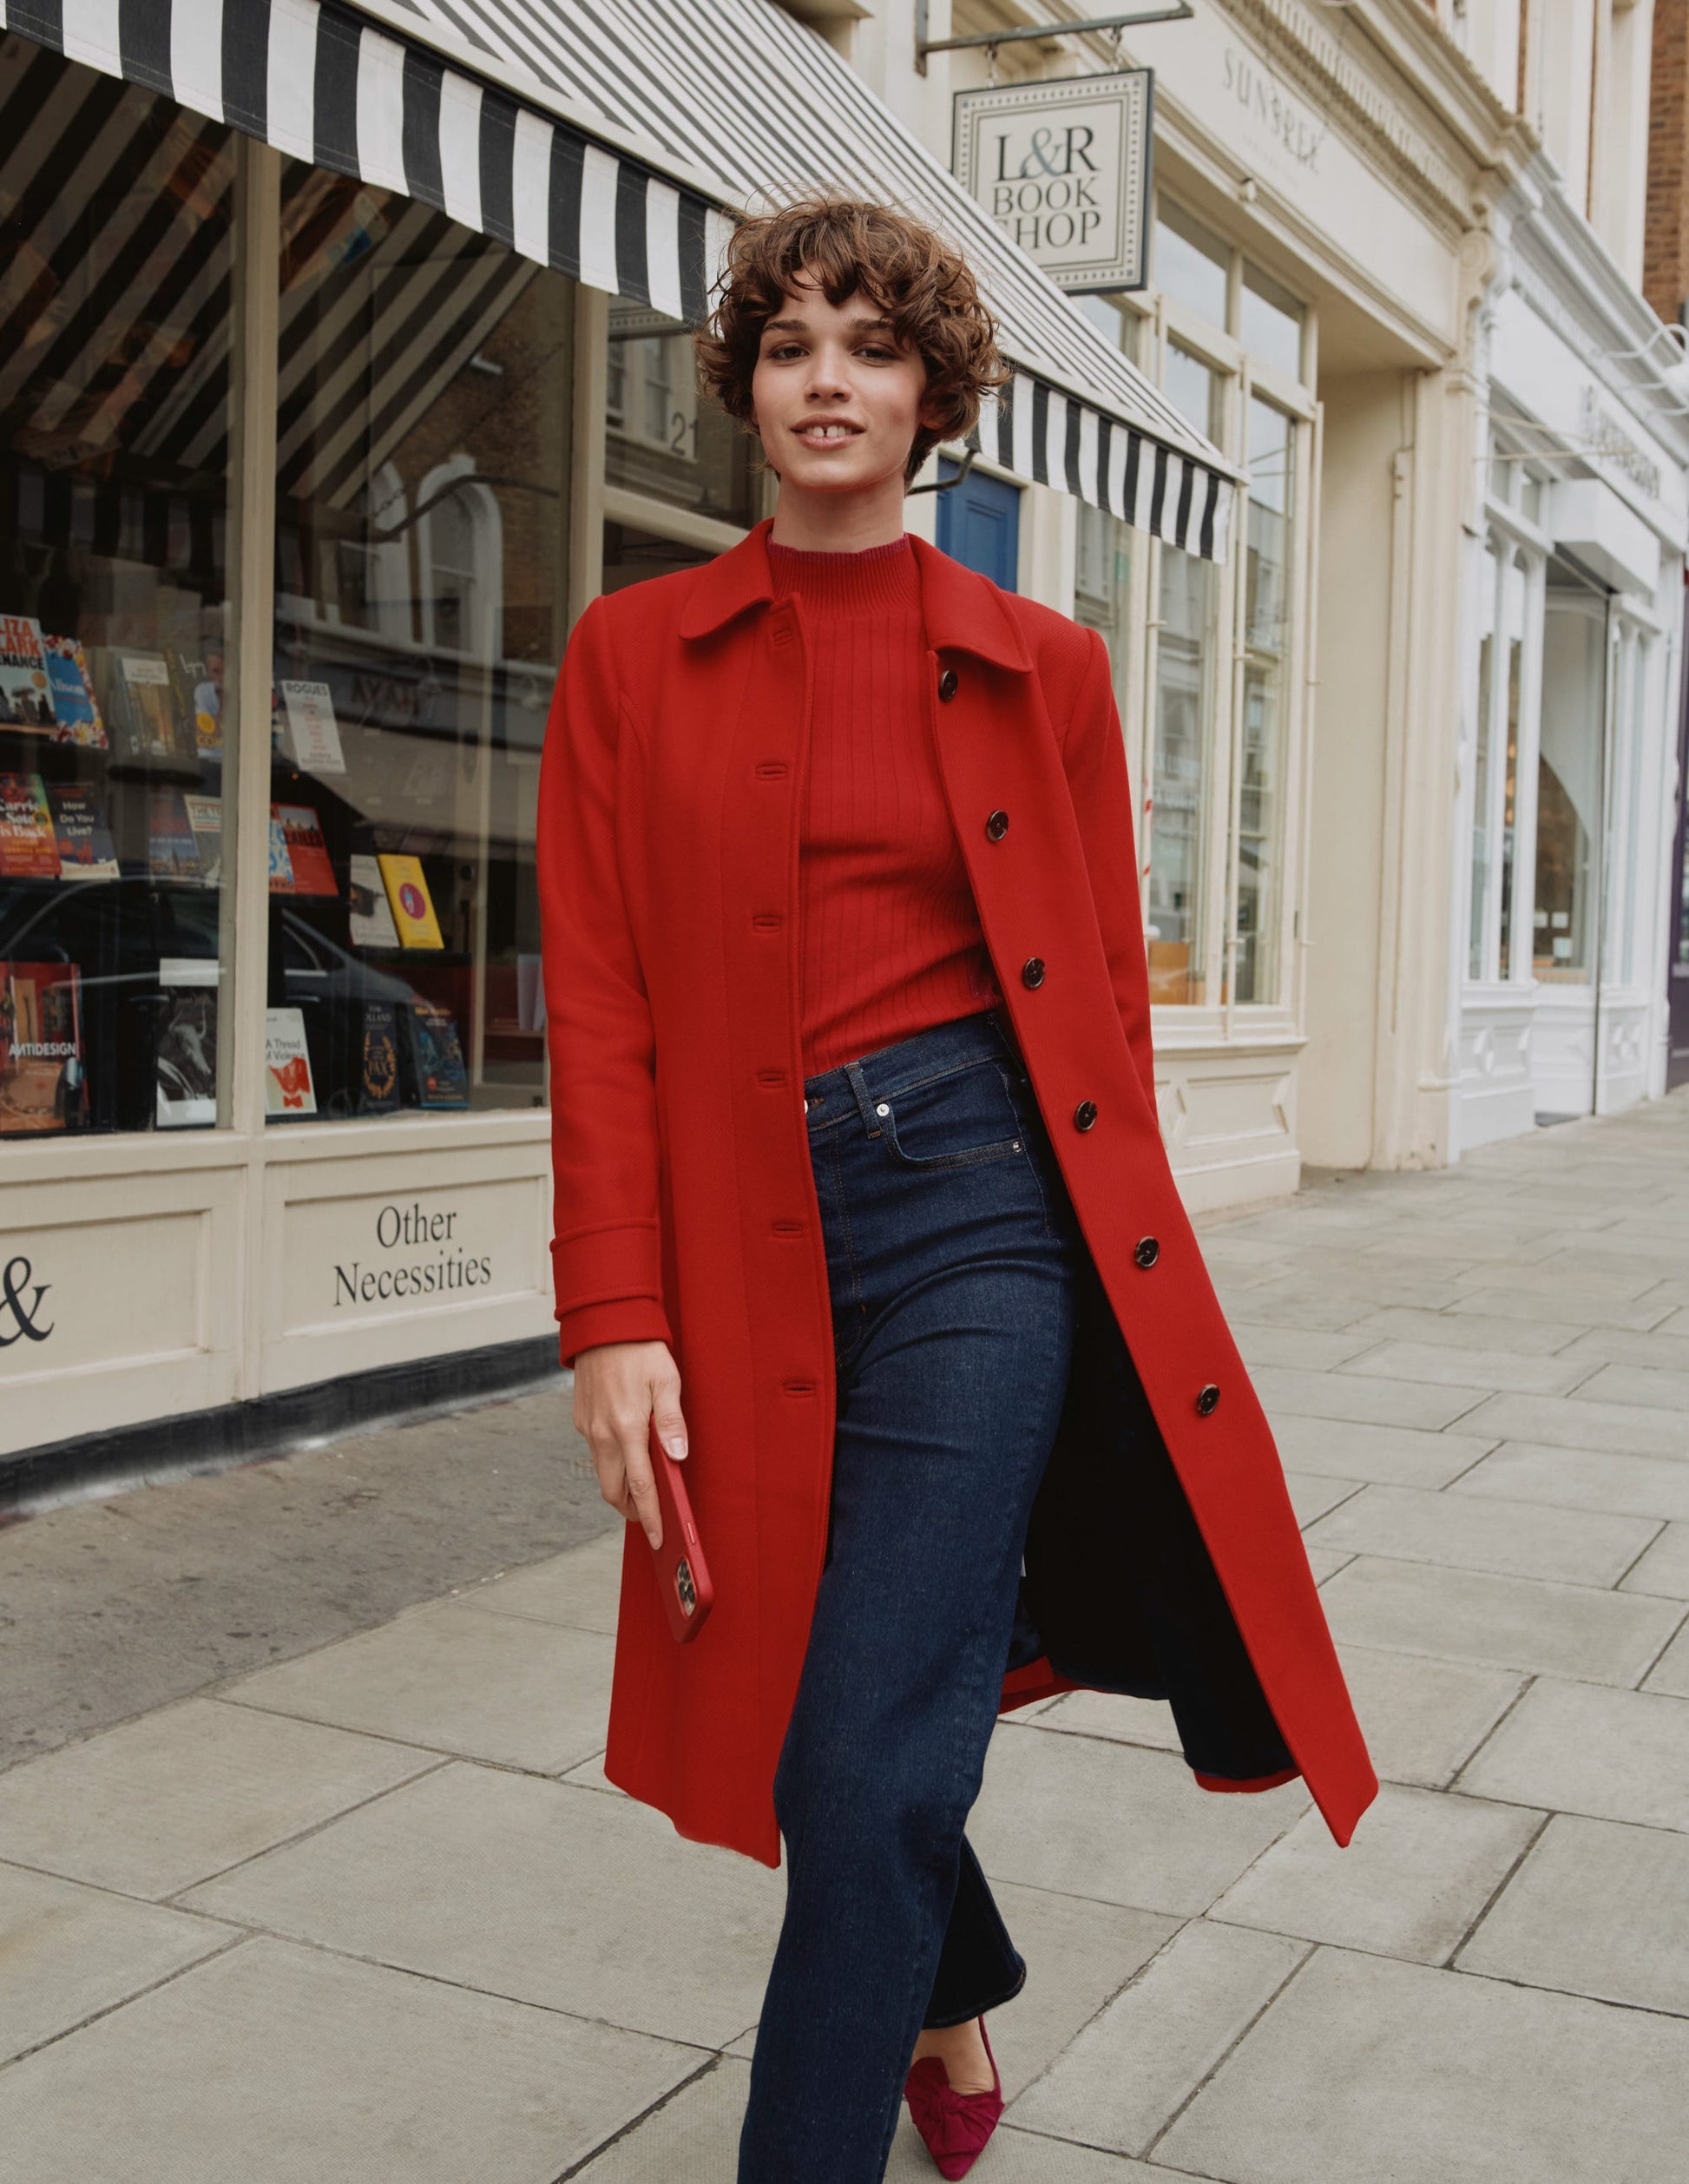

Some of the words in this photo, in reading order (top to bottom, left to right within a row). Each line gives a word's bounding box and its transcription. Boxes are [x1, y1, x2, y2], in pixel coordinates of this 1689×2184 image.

[996, 125, 1101, 182] L&R
[993, 176, 1101, 216] BOOK
[286, 682, 328, 695] ROGUES
[62, 801, 86, 812] How
[59, 813, 75, 825] Do
[75, 813, 95, 825] You
[67, 826, 93, 837] Live?
[274, 1038, 301, 1049] Thread
[369, 1061, 391, 1077] PAX
[377, 1203, 457, 1249] Other
[332, 1248, 491, 1307] Necessities
[0, 1255, 55, 1347] &
